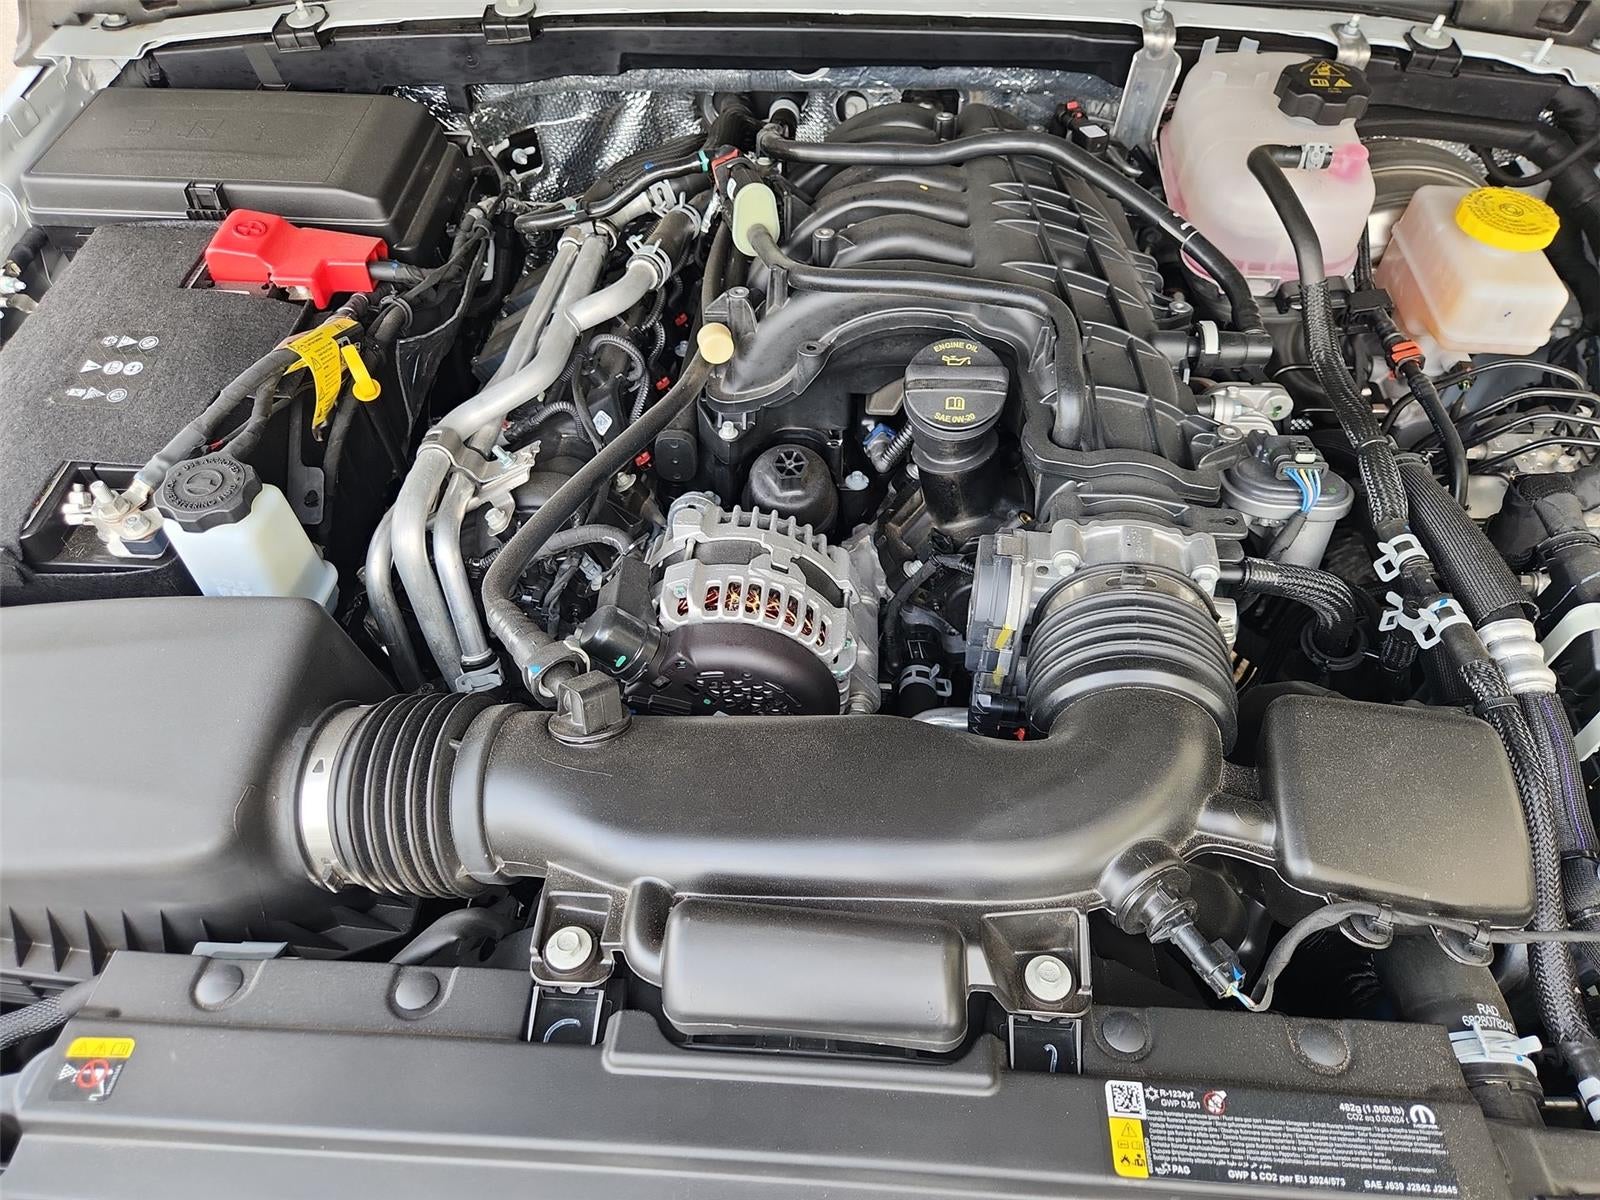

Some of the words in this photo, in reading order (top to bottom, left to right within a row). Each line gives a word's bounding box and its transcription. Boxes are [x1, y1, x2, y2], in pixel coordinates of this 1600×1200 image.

[933, 342, 964, 353] ENGINE
[965, 343, 978, 353] OIL
[934, 412, 951, 423] SAE
[1160, 1098, 1180, 1108] GWP
[1391, 1105, 1405, 1117] lb)
[1346, 1112, 1364, 1122] CO2
[1172, 1164, 1191, 1175] PAG
[1227, 1169, 1249, 1179] GWP
[1259, 1172, 1278, 1182] CO2
[1279, 1175, 1293, 1184] per
[1294, 1174, 1308, 1183] EU
[1364, 1179, 1383, 1189] SAE
